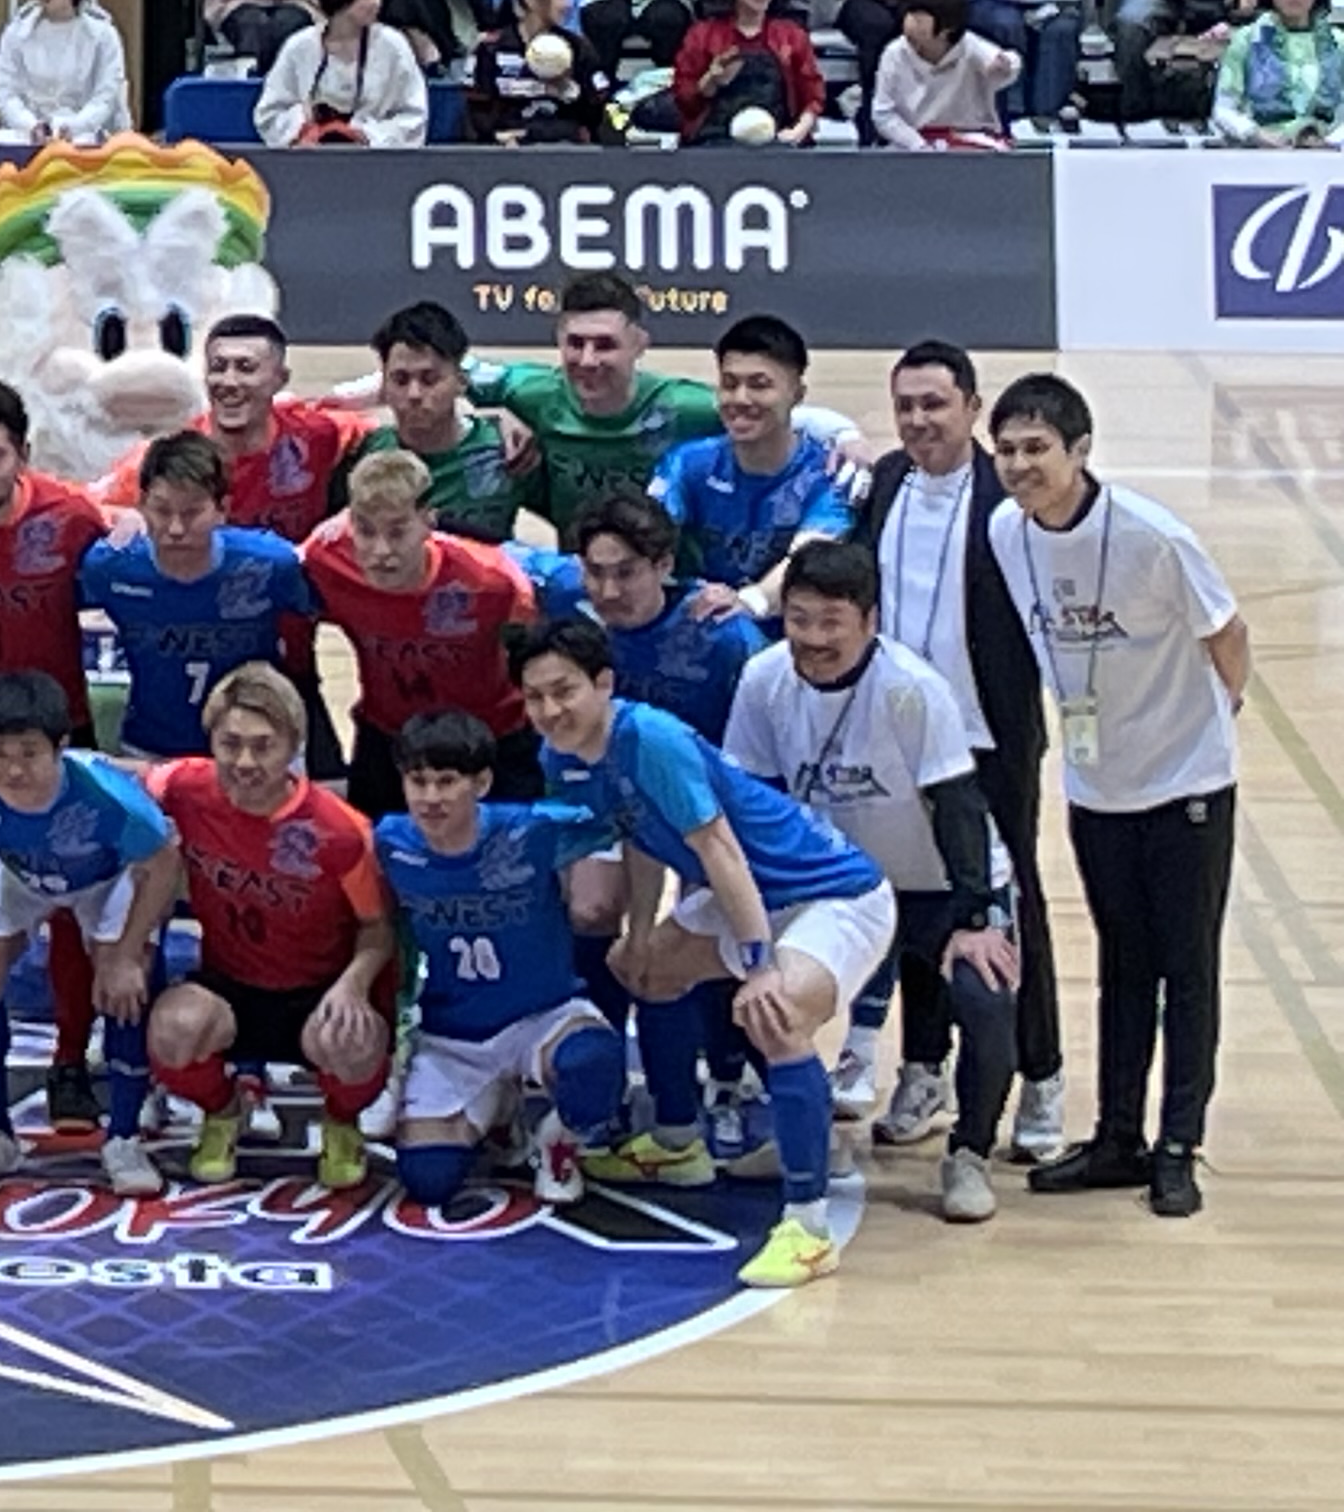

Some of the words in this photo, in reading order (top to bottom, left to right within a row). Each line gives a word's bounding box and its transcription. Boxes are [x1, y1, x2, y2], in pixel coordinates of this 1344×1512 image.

[411, 183, 790, 272] ABEMA
[473, 285, 512, 311] TV
[523, 285, 559, 312] fo
[185, 662, 210, 705] 7
[449, 936, 502, 981] 20
